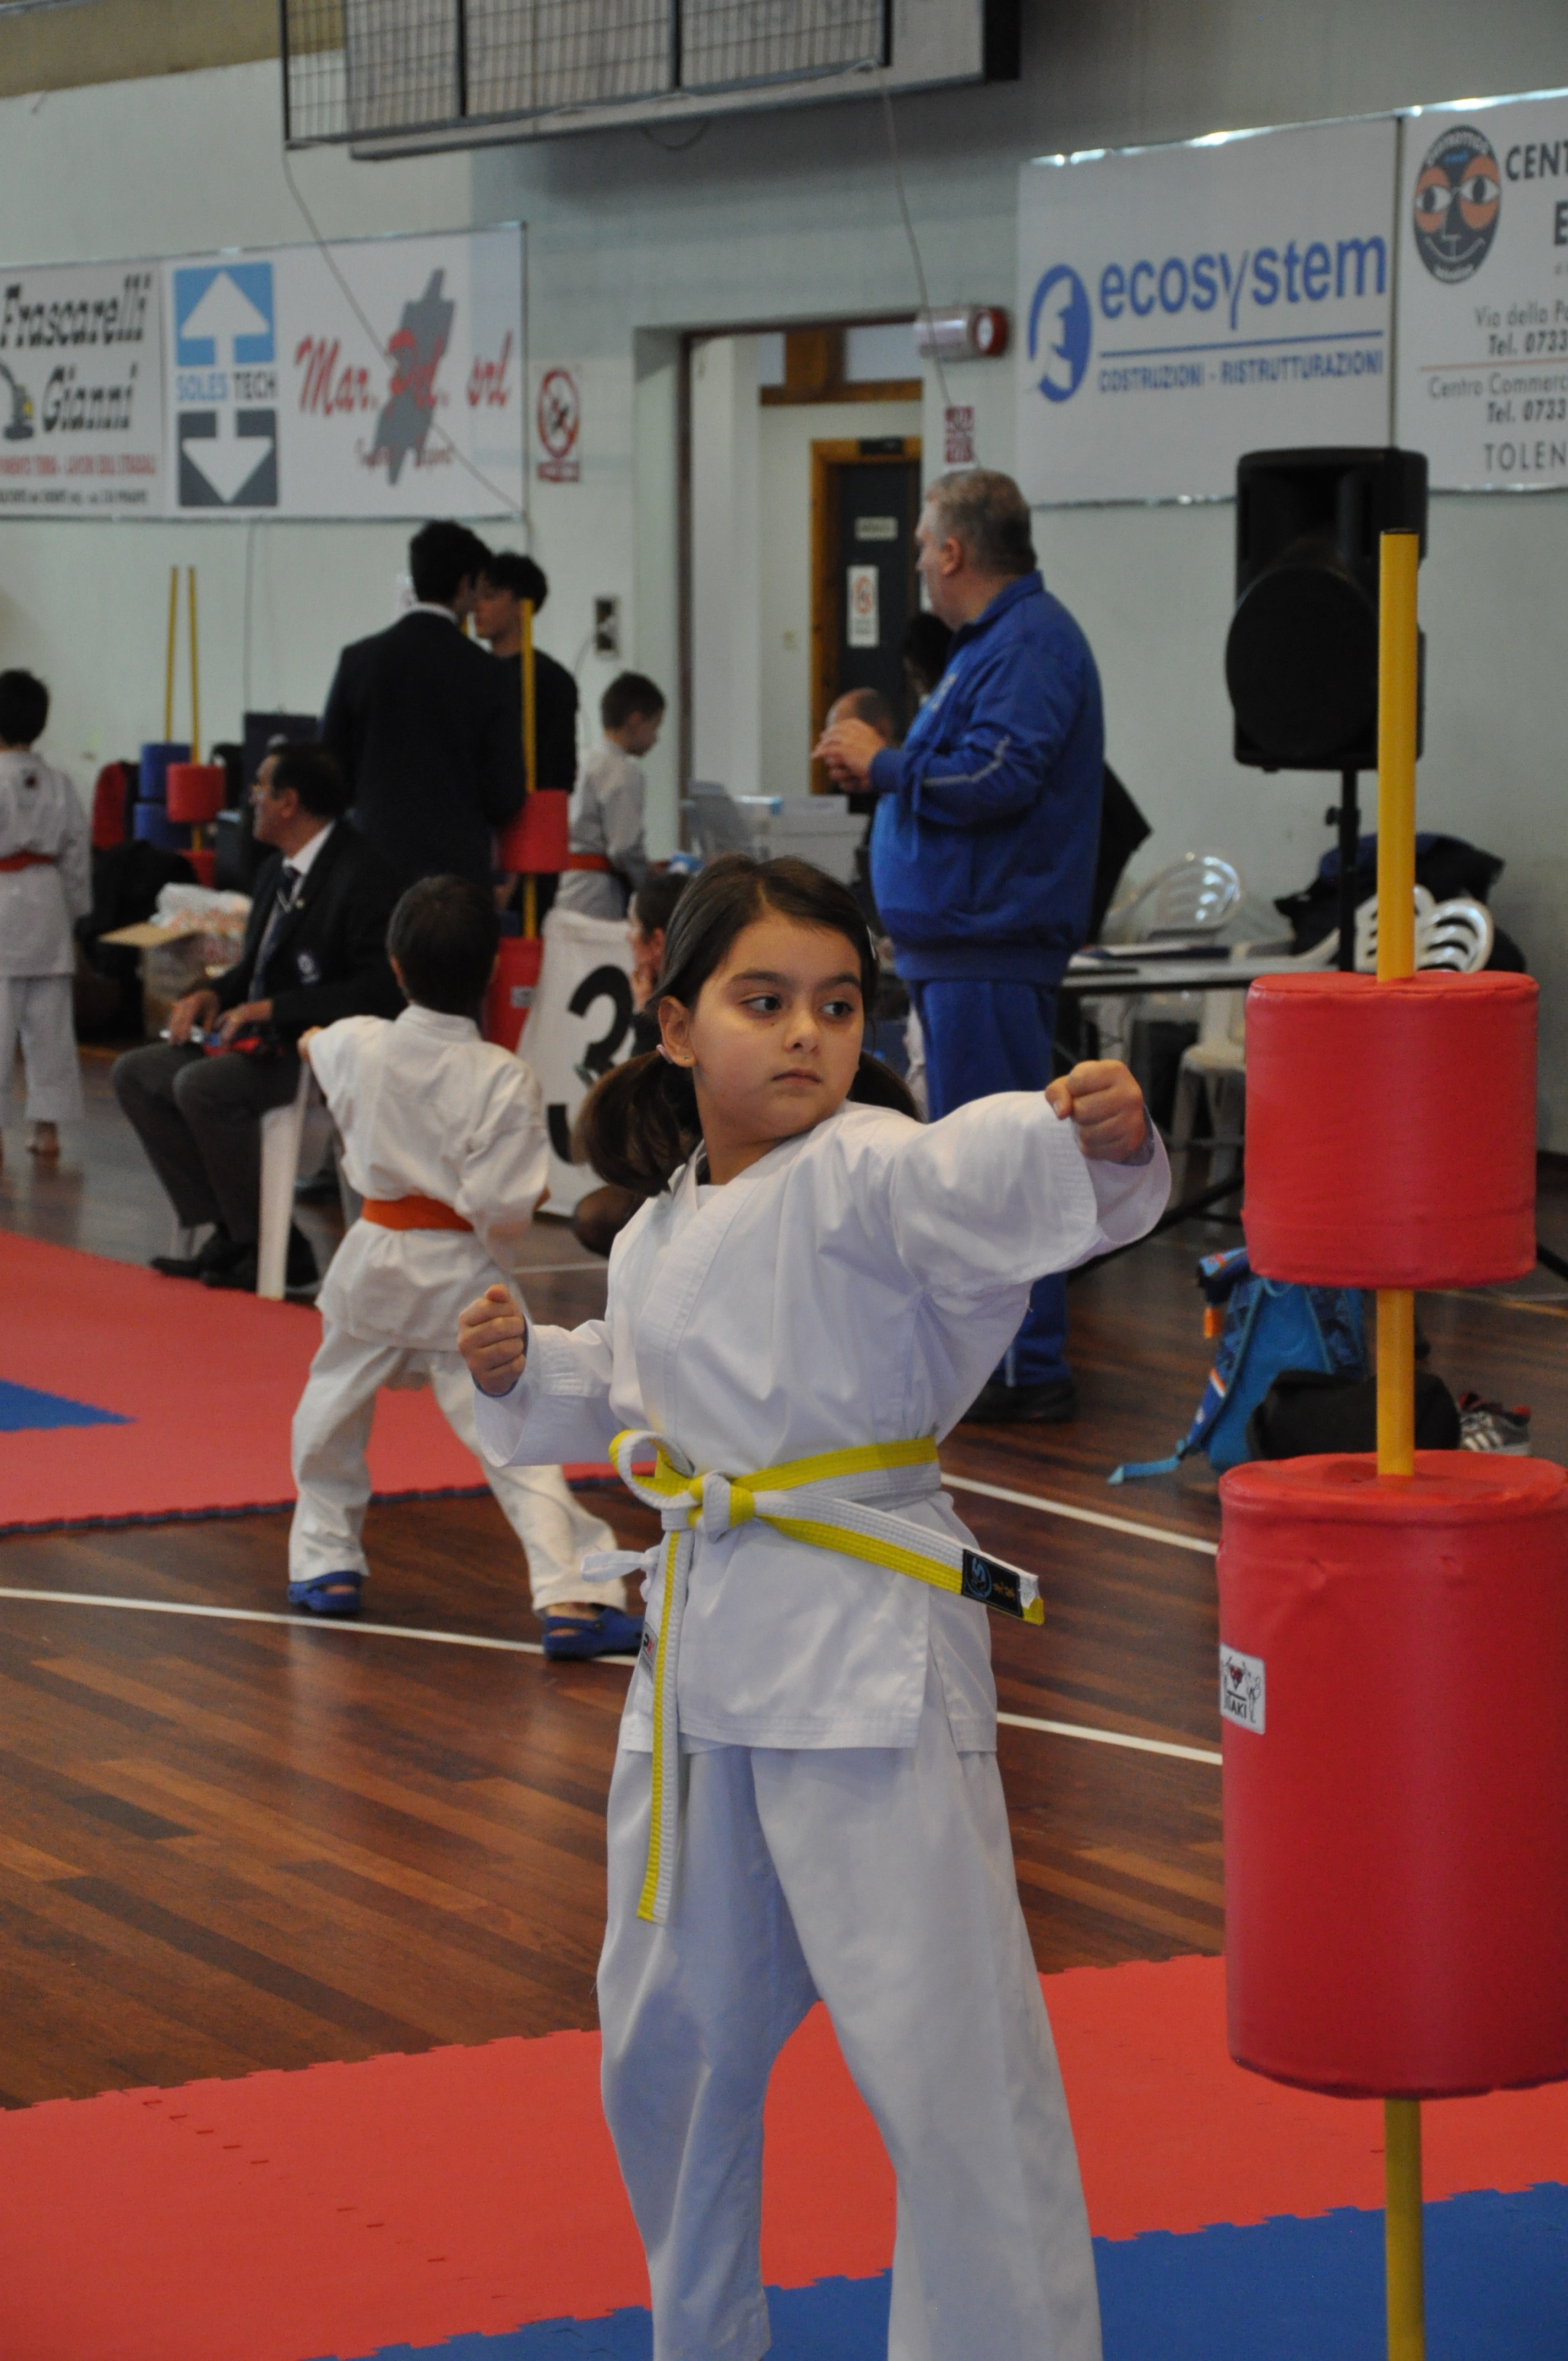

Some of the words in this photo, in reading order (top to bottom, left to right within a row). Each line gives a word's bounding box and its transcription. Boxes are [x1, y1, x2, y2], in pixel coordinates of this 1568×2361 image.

[1100, 235, 1386, 330] ecosystem
[1489, 331, 1517, 356] Tel.
[1525, 330, 1568, 353] 0733
[1219, 349, 1384, 385] RISTRUTTURAZIONI
[234, 370, 277, 400] TECH
[1488, 400, 1516, 422] Tel.
[1523, 398, 1567, 422] 0733
[1484, 440, 1567, 471] TOLEN
